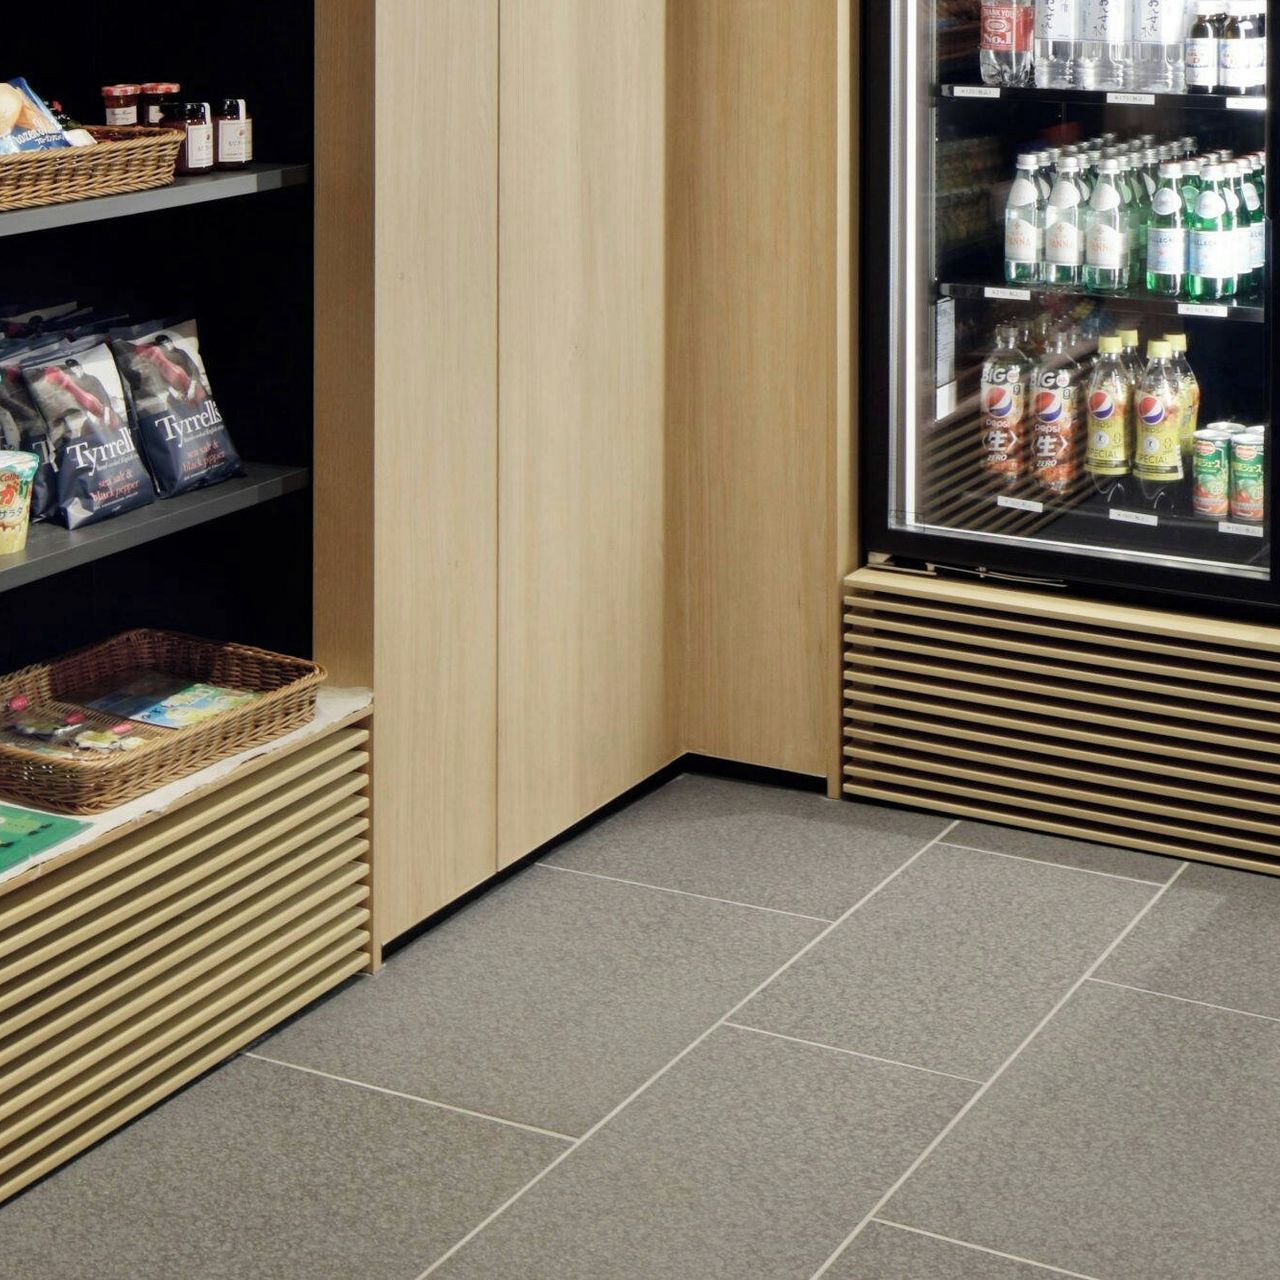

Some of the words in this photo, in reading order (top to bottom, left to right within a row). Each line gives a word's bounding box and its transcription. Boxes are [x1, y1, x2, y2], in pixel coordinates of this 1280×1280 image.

[983, 31, 1013, 45] No.1
[981, 367, 1007, 383] BIG
[986, 420, 1010, 429] pepsi
[1035, 424, 1061, 434] pepsi
[988, 430, 1007, 452] 生
[1037, 435, 1057, 457] 生
[66, 426, 136, 477] Tyrrell
[987, 454, 1008, 462] ZERO
[1036, 459, 1058, 468] ZERO
[89, 490, 115, 502] black
[114, 480, 140, 498] pepper
